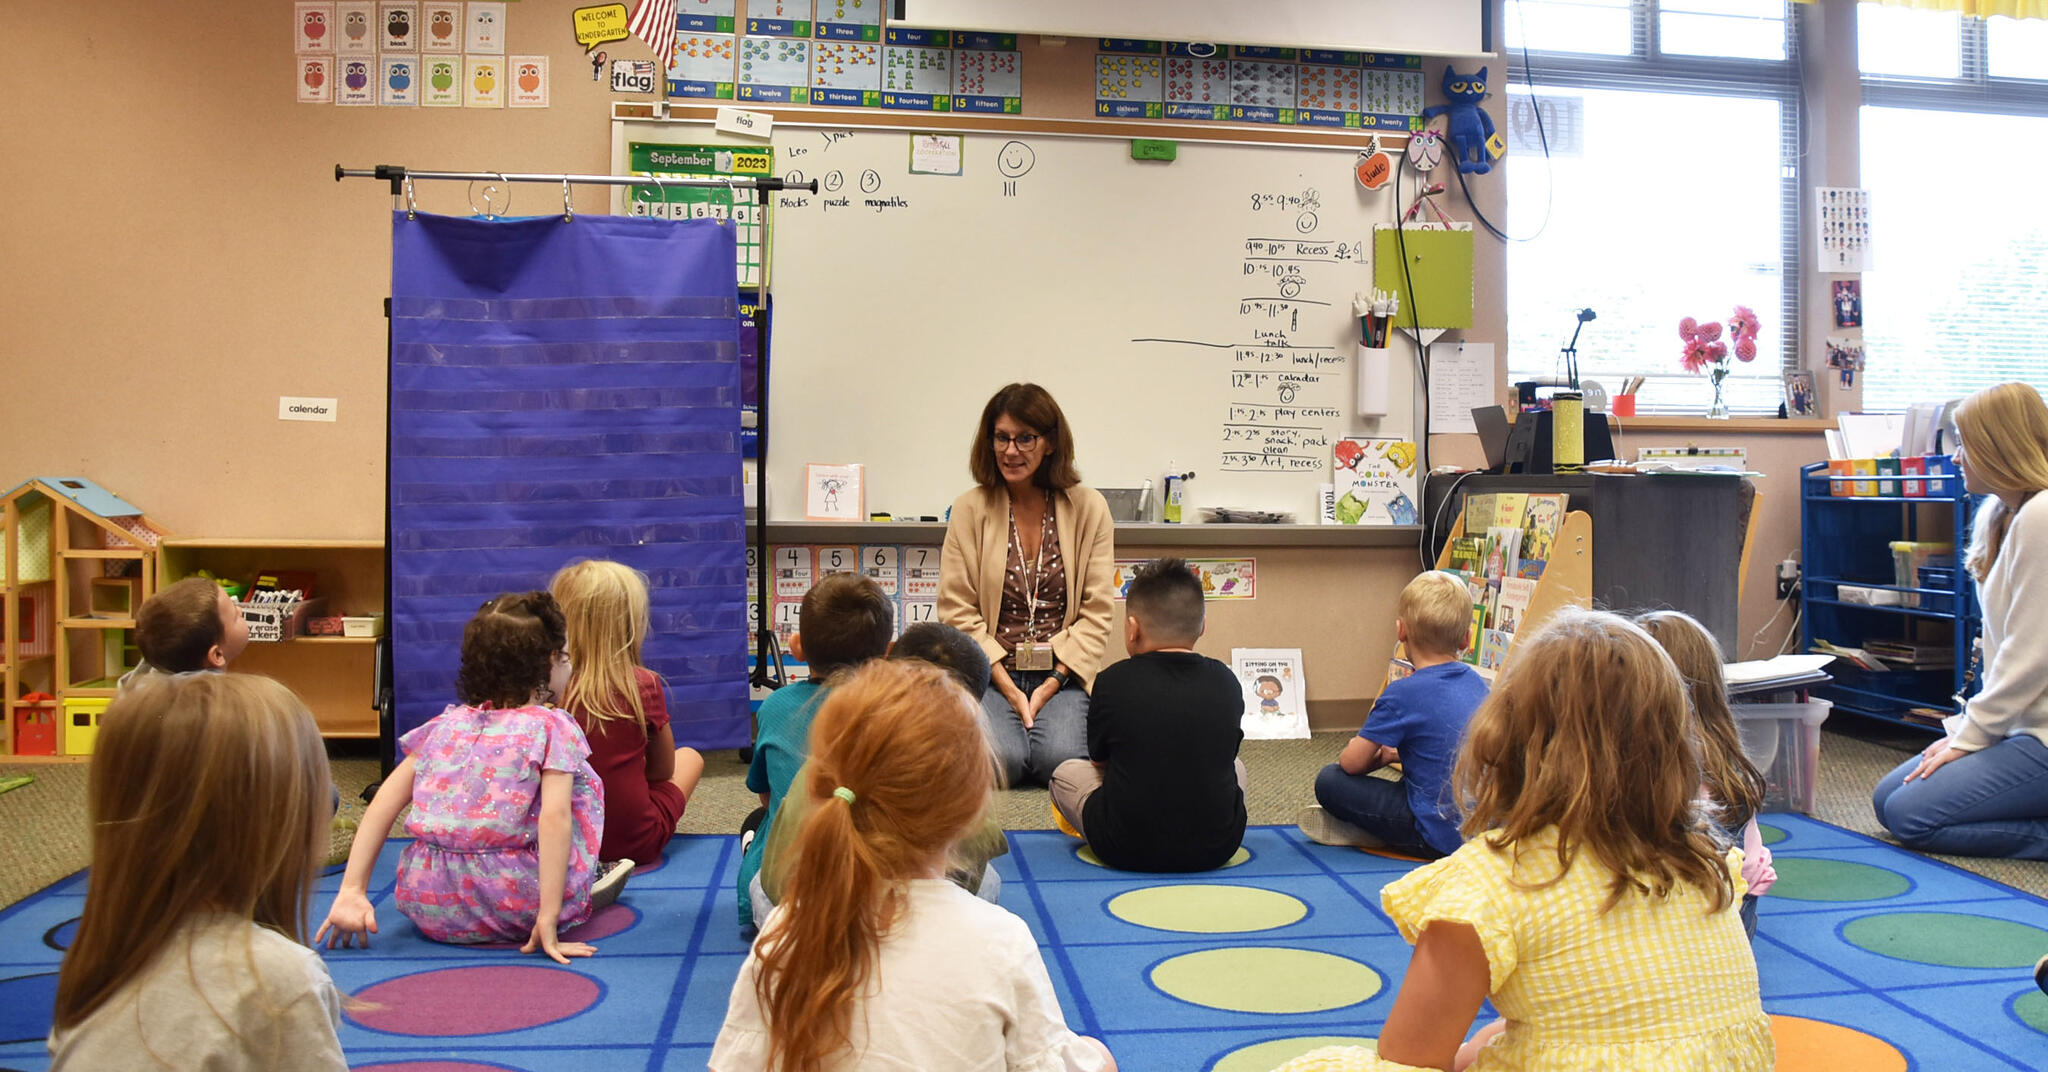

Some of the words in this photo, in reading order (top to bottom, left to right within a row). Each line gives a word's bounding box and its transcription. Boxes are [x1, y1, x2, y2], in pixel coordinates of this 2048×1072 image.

[581, 10, 617, 22] WELCOME
[750, 22, 758, 32] 2
[820, 26, 826, 36] 3
[836, 27, 854, 35] three
[578, 28, 626, 40] KINDERGARTEN
[888, 32, 897, 41] 4
[957, 34, 964, 44] 5
[1104, 38, 1111, 48] 6
[1171, 43, 1178, 52] 7
[1304, 50, 1312, 58] 9
[1364, 54, 1375, 64] 10
[614, 72, 651, 90] flag
[667, 83, 676, 92] 11
[684, 84, 706, 92] eleven
[740, 87, 752, 97] 12
[758, 89, 782, 97] twelve
[814, 91, 825, 101] 13
[829, 93, 856, 101] thirteen
[884, 95, 896, 104] 14
[898, 98, 929, 106] fourteen
[956, 98, 967, 108] 15
[976, 100, 999, 108] fifteen
[1098, 104, 1110, 113] 16
[1168, 105, 1178, 114] 17
[1232, 108, 1244, 118] 18
[1246, 110, 1274, 119] eighteen
[736, 116, 754, 128] flag
[1300, 112, 1311, 121] 19
[1313, 114, 1340, 122] nineteen
[1363, 116, 1377, 126] 20
[1381, 118, 1403, 127] twenty
[788, 146, 808, 158] Leo
[650, 152, 712, 167] September
[737, 156, 767, 168] 2023
[1365, 162, 1386, 183] Jude
[780, 197, 809, 208] Blocks
[824, 196, 850, 212] puzzle
[637, 205, 644, 214] 3
[676, 206, 682, 216] 5
[696, 208, 704, 217] 6
[715, 209, 722, 218] 7
[737, 210, 744, 219] 8
[1296, 243, 1329, 255] Recess
[1254, 330, 1286, 339] Lunch
[1264, 339, 1289, 348] talk
[288, 404, 328, 414] calendar
[1274, 408, 1297, 420] play
[1301, 408, 1340, 418] centers
[1302, 436, 1328, 449] pack
[1262, 446, 1289, 454] clean
[1260, 456, 1284, 470] Art,
[1290, 458, 1323, 469] recess
[1359, 471, 1393, 479] COLOR
[1352, 480, 1400, 488] MONSTER
[1324, 491, 1336, 520] TODAY?
[746, 548, 756, 566] 3
[788, 549, 798, 566] 4
[832, 550, 842, 568] 5
[874, 548, 886, 566] 6
[918, 550, 928, 566] 7
[750, 604, 759, 620] 3
[912, 604, 932, 621] 17
[254, 624, 279, 632] erase
